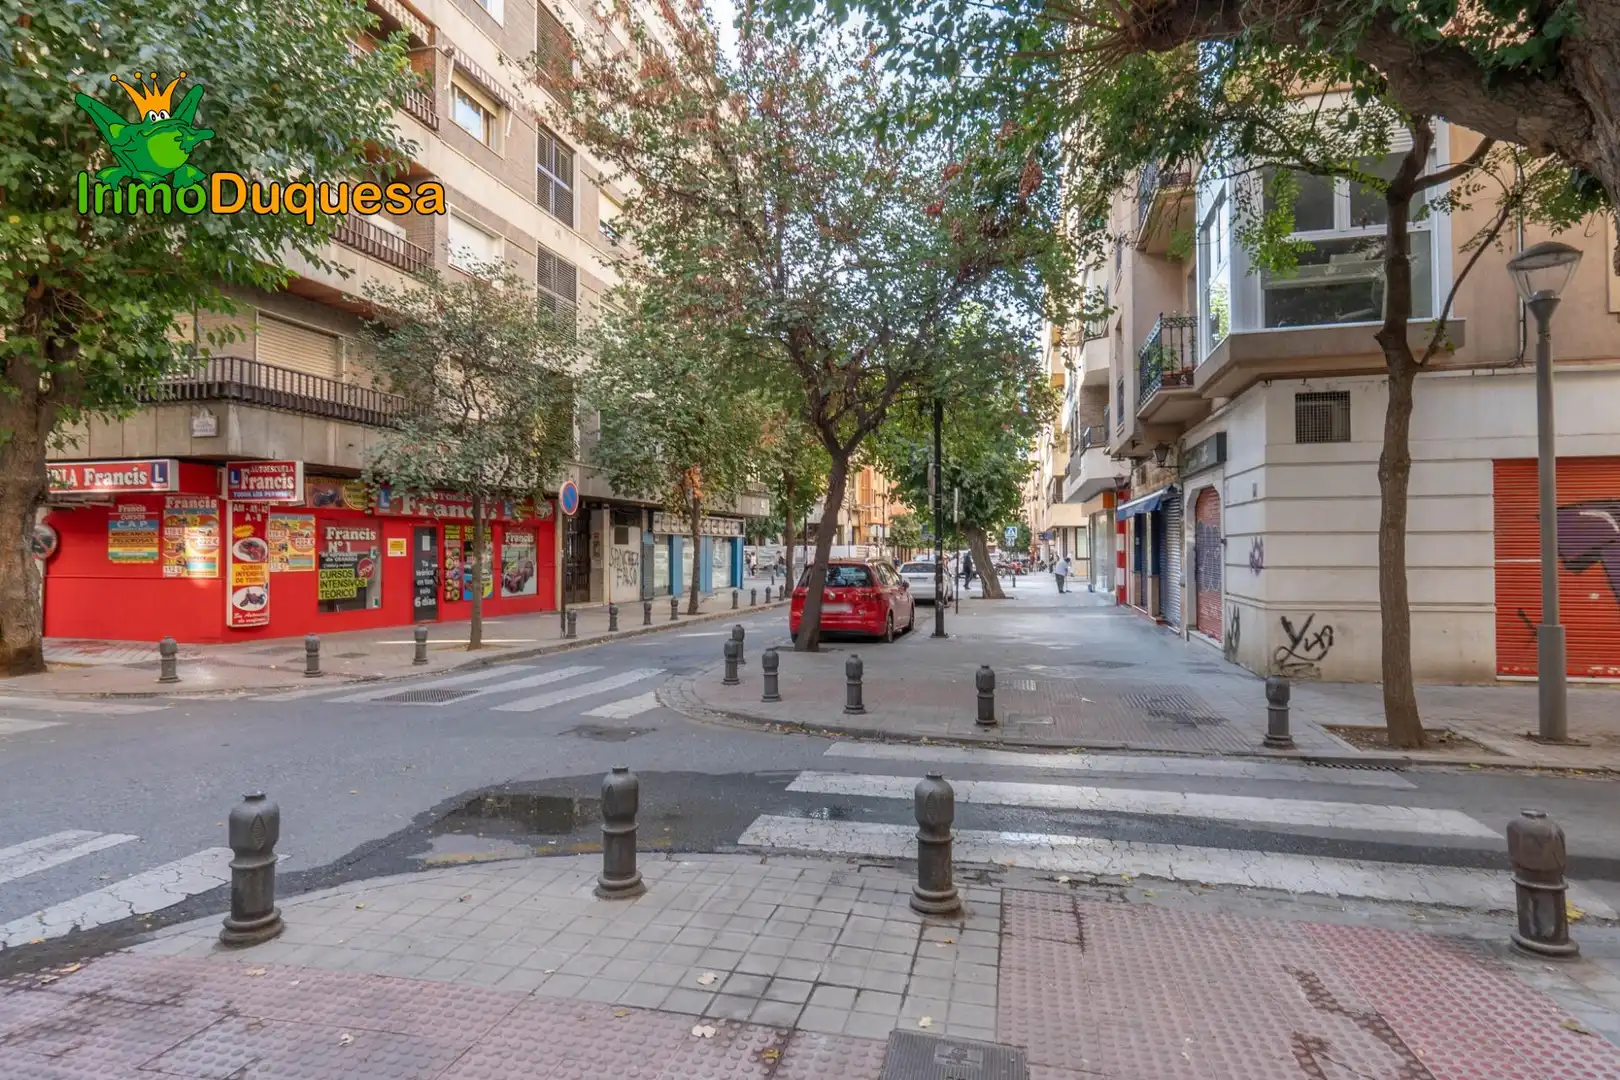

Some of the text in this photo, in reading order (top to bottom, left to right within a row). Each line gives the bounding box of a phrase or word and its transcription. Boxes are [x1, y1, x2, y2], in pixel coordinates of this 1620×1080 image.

[84, 466, 148, 487] Francis
[154, 463, 164, 483] L
[241, 468, 295, 490] Francis
[118, 503, 147, 513] Francis
[165, 496, 217, 509] Francis
[325, 526, 377, 541] Francis
[505, 531, 534, 543] Francis
[319, 569, 353, 579] CURSOS
[359, 563, 374, 577] STOP
[319, 578, 366, 589] INTENSIVOS
[414, 596, 421, 608] 6
